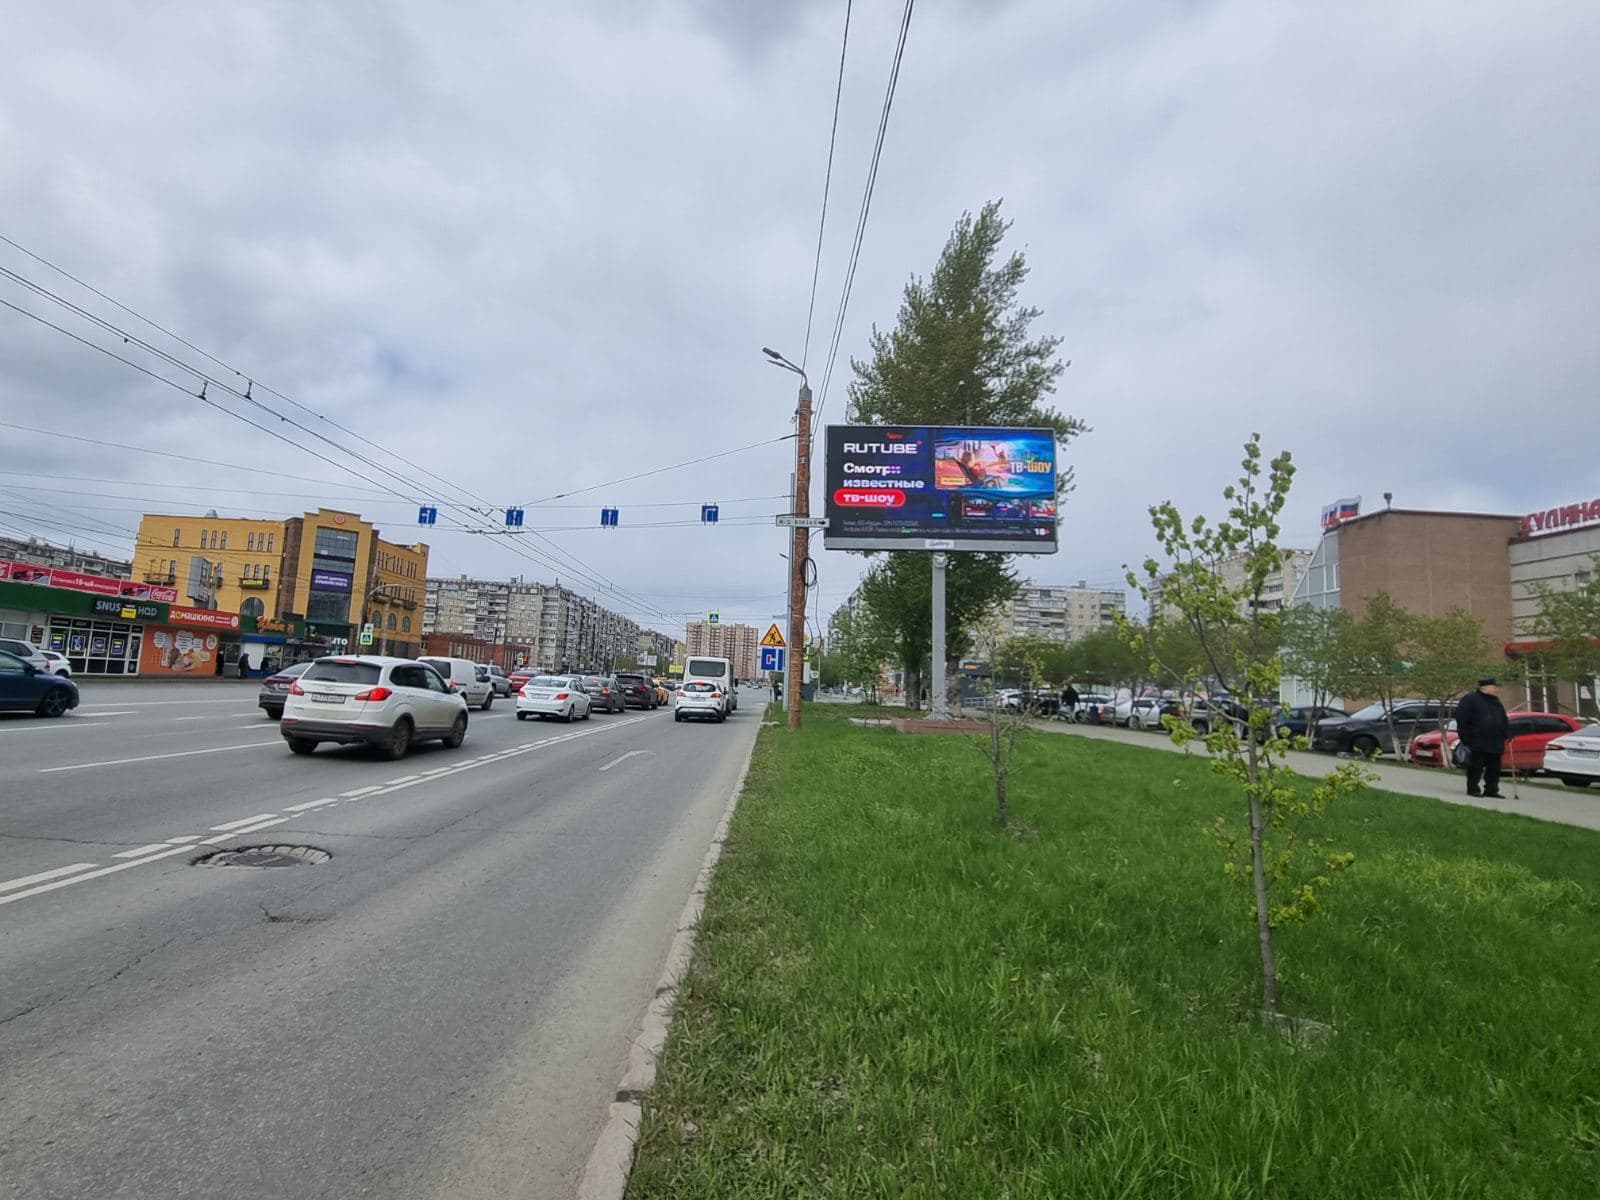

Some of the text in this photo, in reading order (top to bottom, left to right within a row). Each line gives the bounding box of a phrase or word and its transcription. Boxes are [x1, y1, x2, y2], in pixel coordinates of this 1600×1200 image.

[843, 443, 918, 454] RUTUBE
[843, 479, 925, 489] известные
[843, 494, 895, 506] тв-шоу
[96, 600, 120, 612] SNUS
[138, 605, 158, 616] HQD
